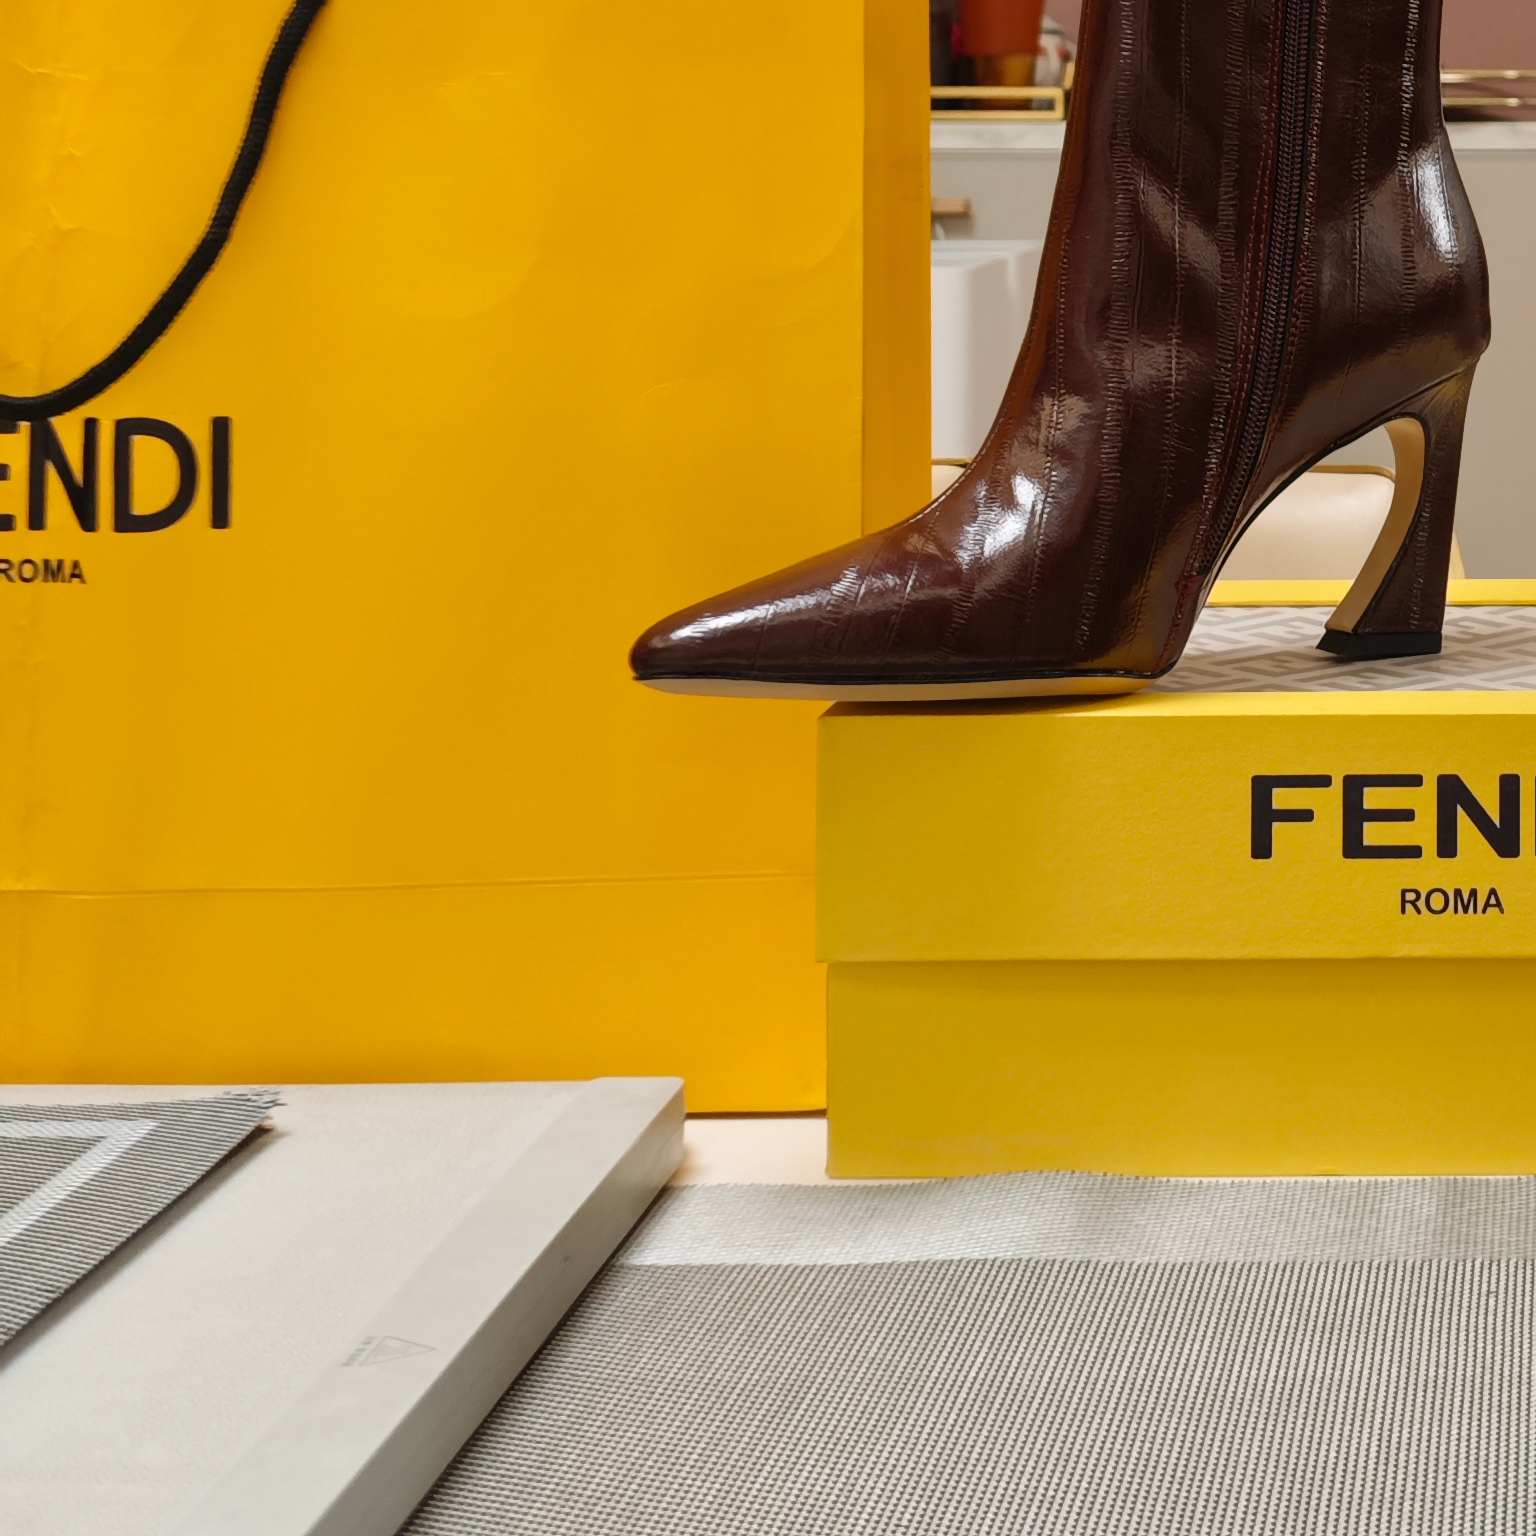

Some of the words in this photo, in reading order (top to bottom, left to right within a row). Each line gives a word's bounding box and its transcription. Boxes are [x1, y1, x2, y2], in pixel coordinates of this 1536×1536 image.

[0, 415, 231, 533] NDI
[0, 558, 87, 584] ROMA
[1400, 887, 1505, 915] ROMA
